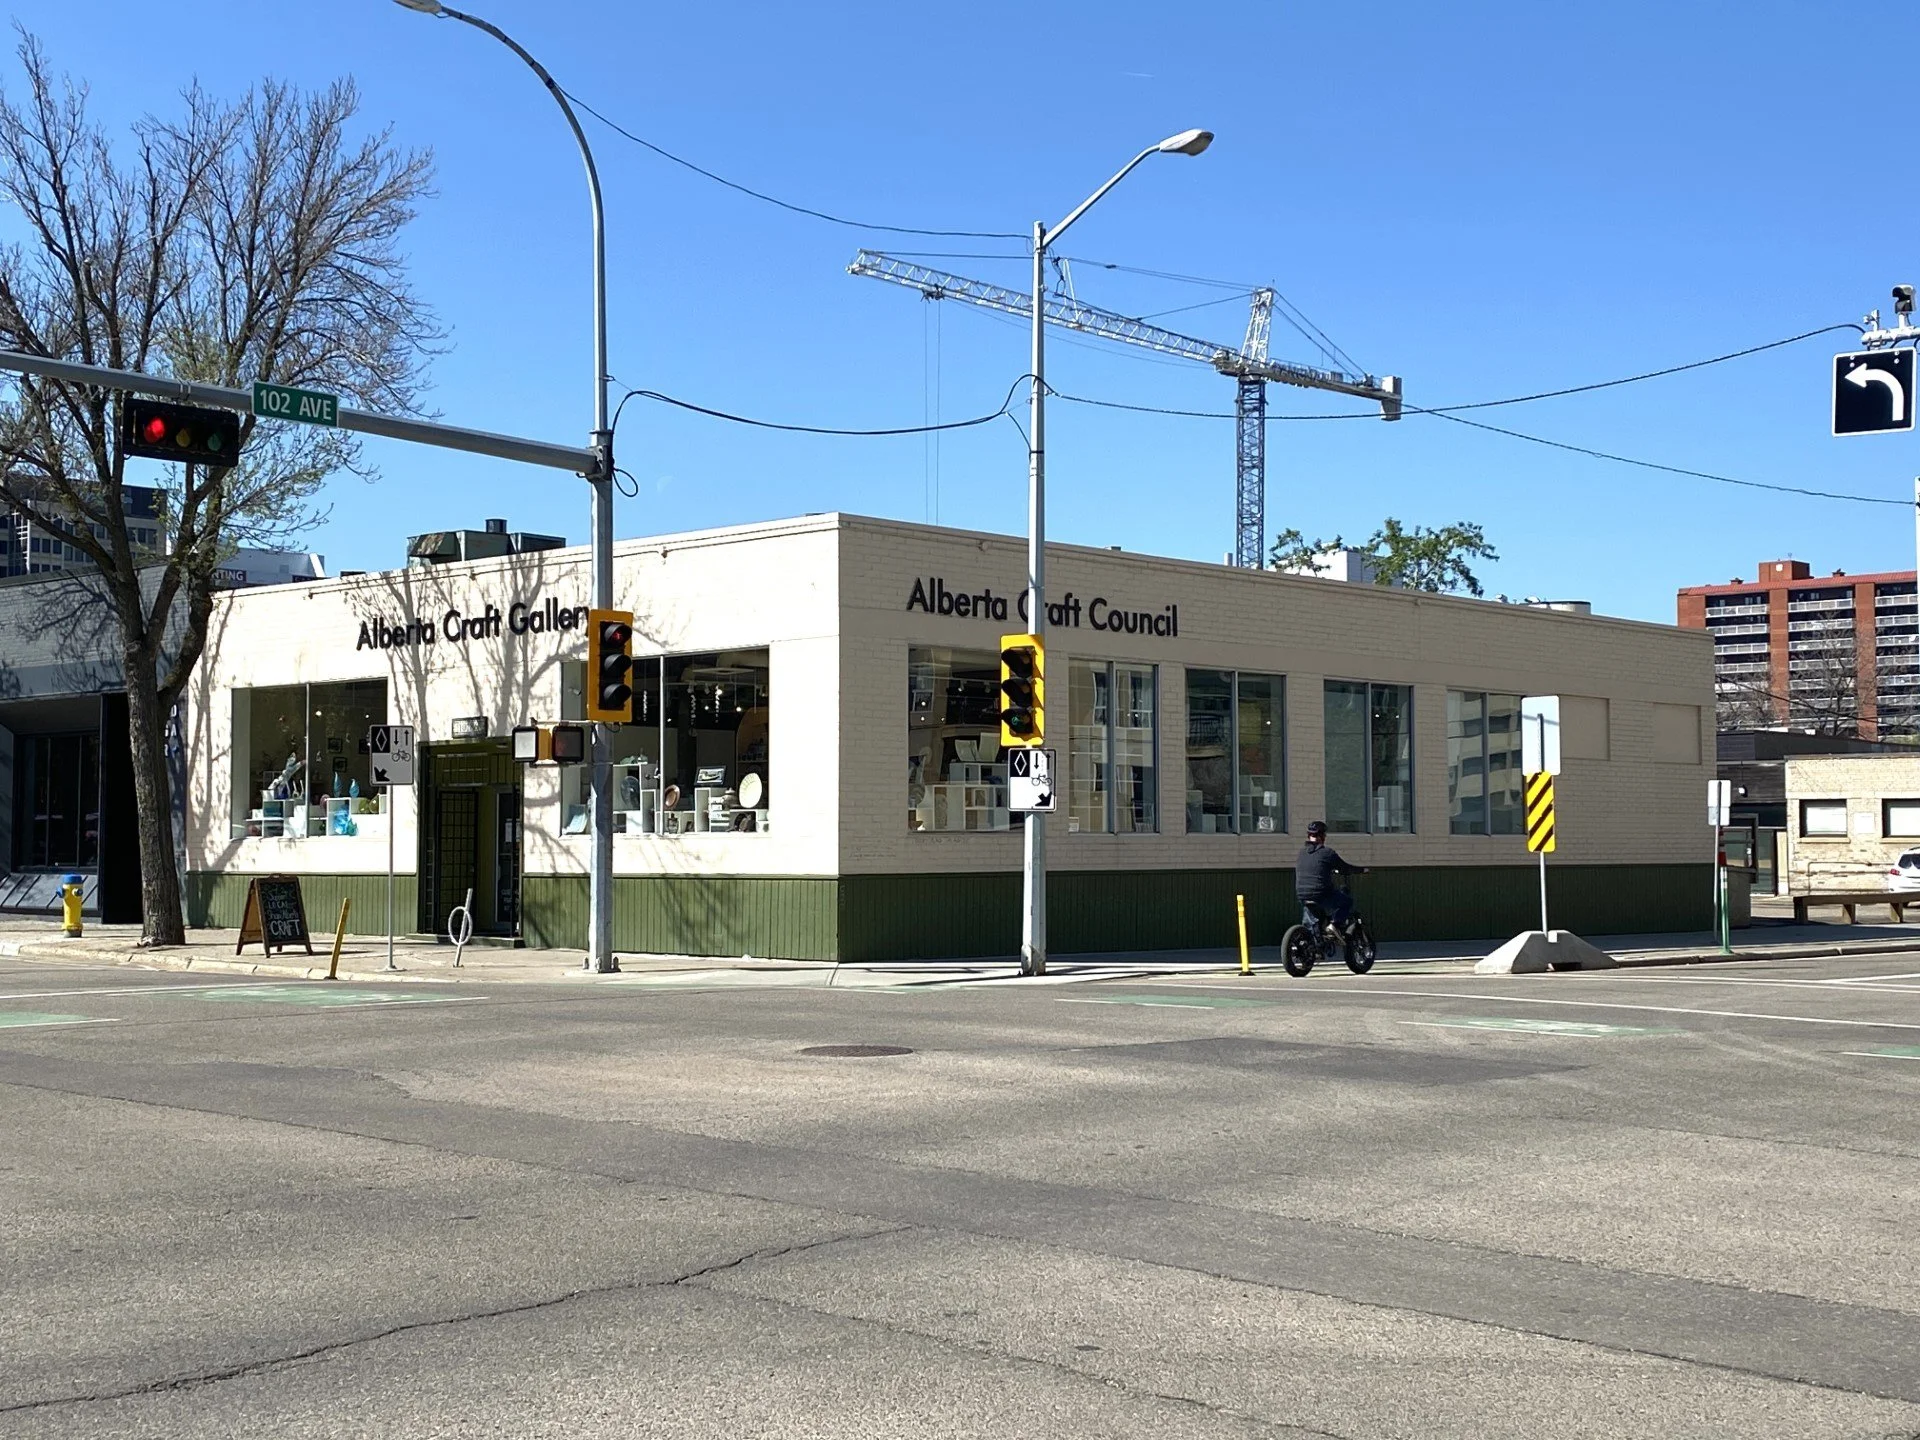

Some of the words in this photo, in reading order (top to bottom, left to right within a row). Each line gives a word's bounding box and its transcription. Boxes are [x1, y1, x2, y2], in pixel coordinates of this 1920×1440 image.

[260, 389, 290, 413] 102
[299, 396, 332, 420] AVE
[211, 569, 244, 581] NTING
[906, 577, 1007, 621] Alberta
[1018, 588, 1081, 627] Caft
[1089, 598, 1178, 637] Council
[356, 617, 435, 651] Alberta
[443, 603, 500, 643] Craft
[270, 920, 300, 936] CRAFT
